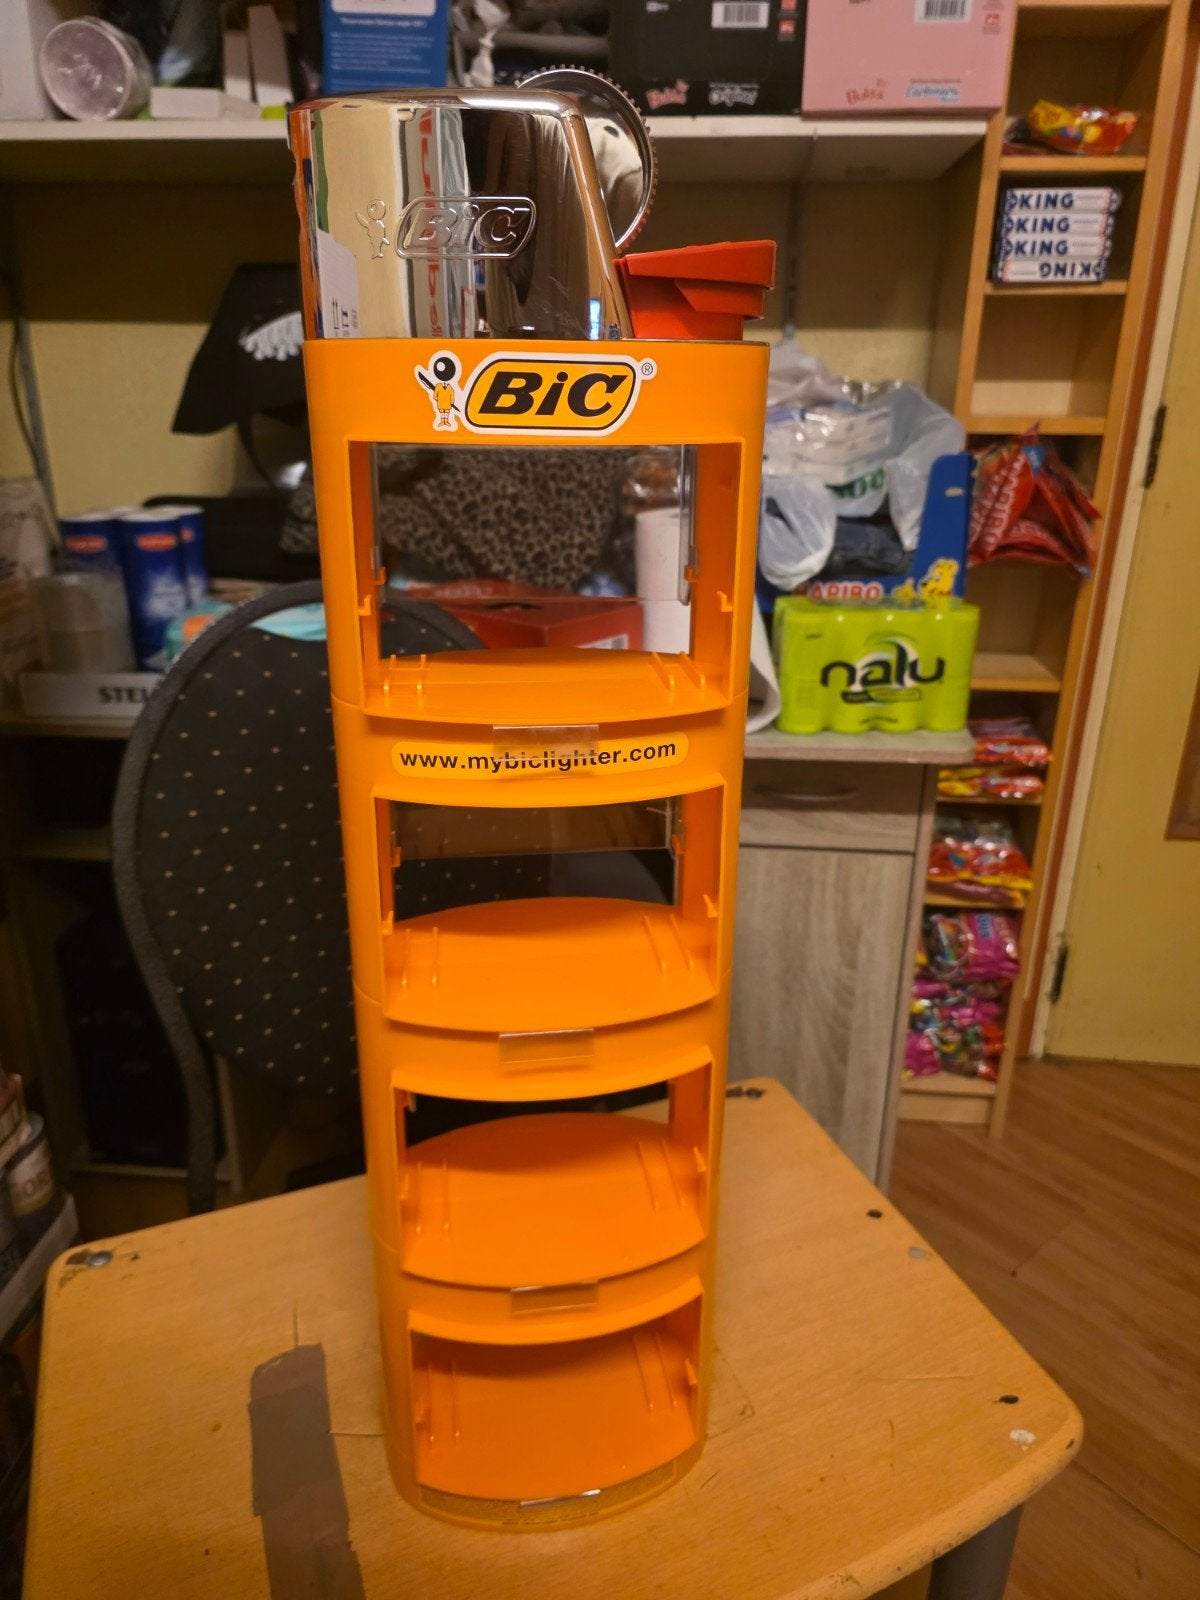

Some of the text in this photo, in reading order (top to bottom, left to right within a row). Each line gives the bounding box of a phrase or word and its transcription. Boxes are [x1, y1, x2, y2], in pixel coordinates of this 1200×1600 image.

[401, 207, 531, 249] BiC
[478, 371, 629, 418] BiC
[820, 640, 946, 687] nalu
[399, 742, 677, 774] www.mybiclighter.com
